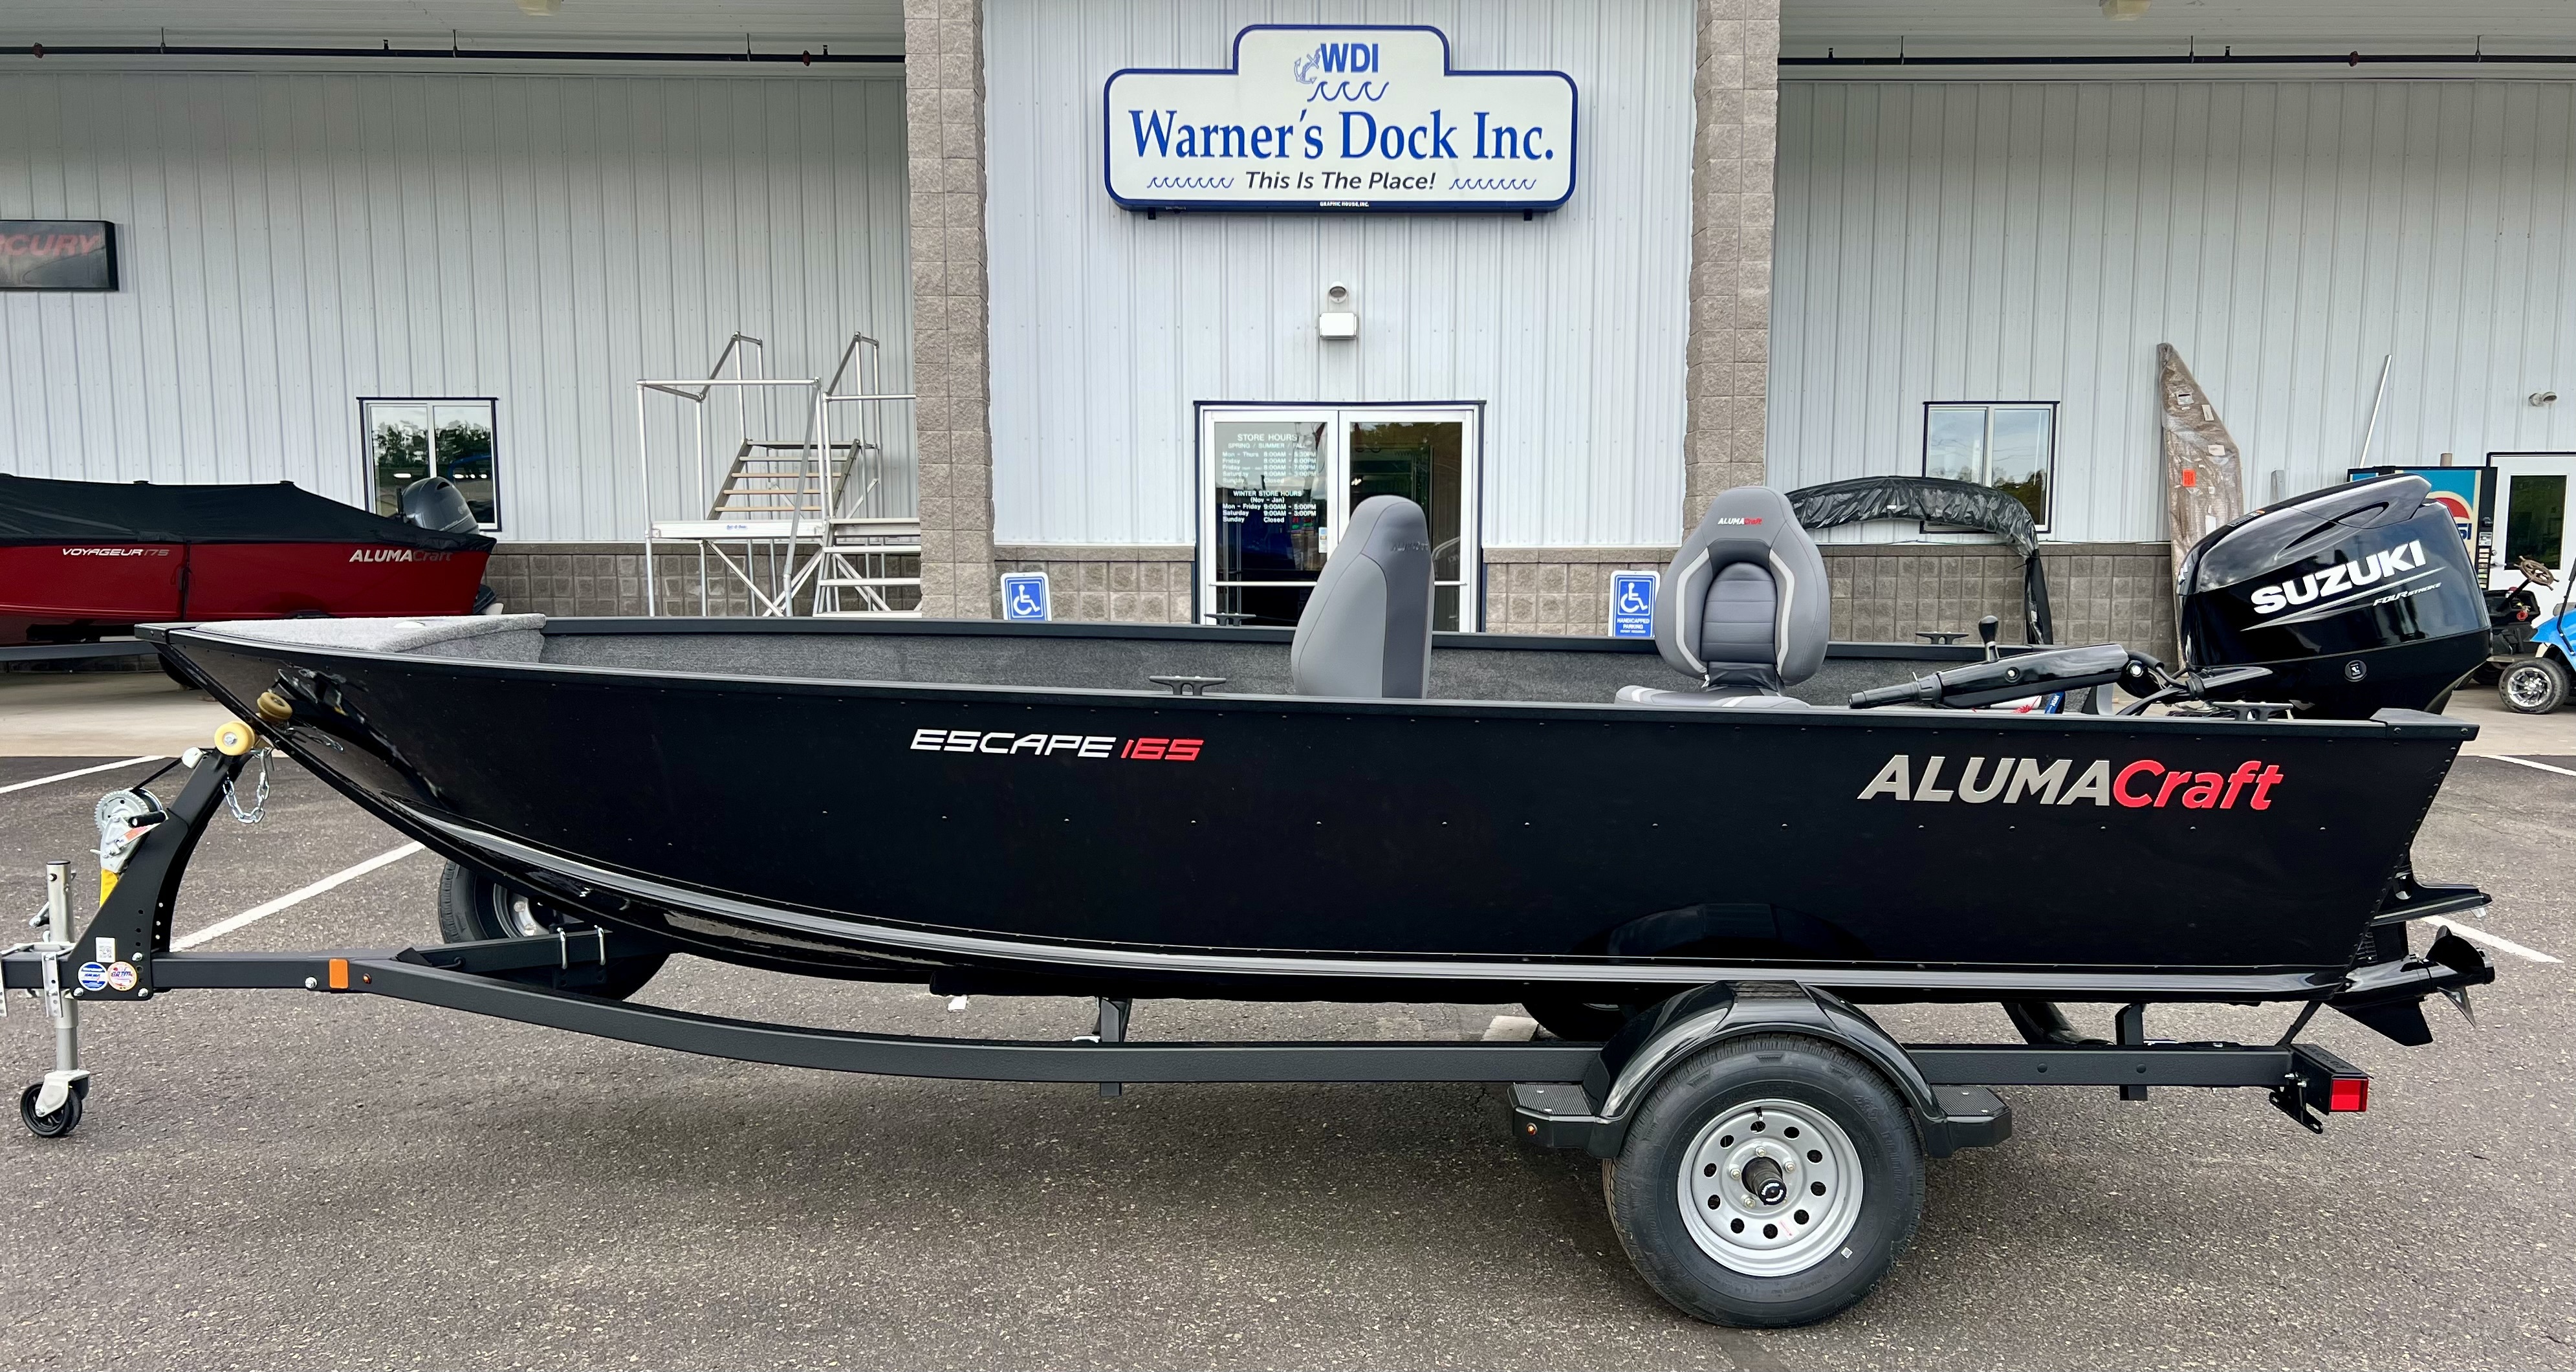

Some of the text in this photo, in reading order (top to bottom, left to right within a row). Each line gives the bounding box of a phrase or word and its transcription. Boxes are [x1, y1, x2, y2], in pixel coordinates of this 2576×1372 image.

[1320, 43, 1379, 73] WDI
[1129, 108, 1554, 160] Warner's Dock Inc.
[1245, 171, 1436, 190] This Is The Place!
[0, 234, 101, 256] CURY
[63, 548, 144, 556] VOYAGEUR
[349, 549, 453, 562] ALUMACraft
[2251, 539, 2427, 614] SUZUKI
[910, 729, 1204, 761] ESCAPE 165
[1857, 754, 2284, 810] ALUMACraft
